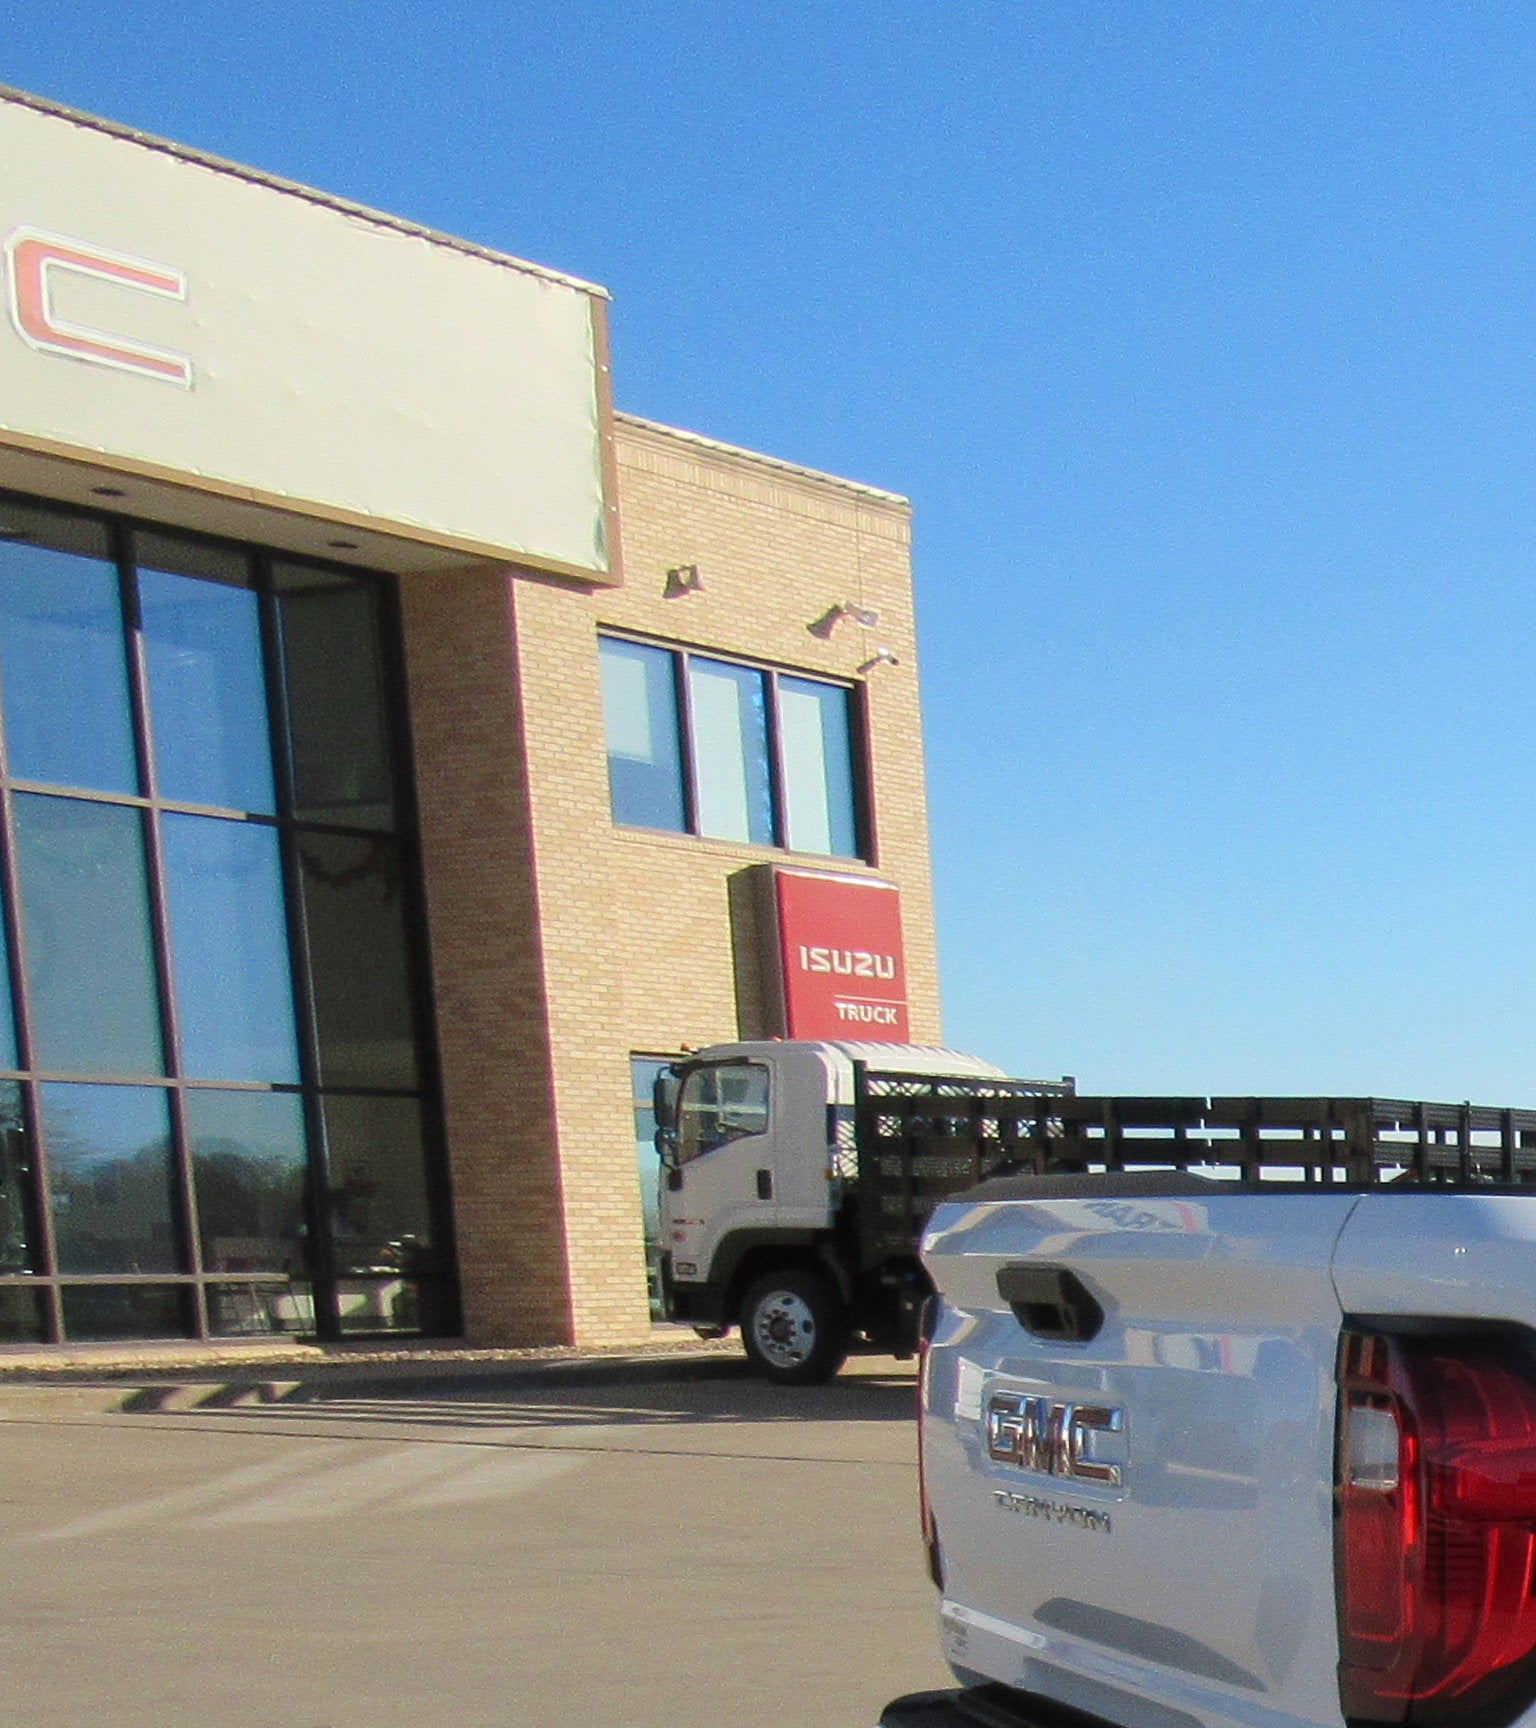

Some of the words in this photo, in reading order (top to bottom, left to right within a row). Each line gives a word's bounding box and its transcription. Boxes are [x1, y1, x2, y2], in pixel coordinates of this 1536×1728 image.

[799, 946, 896, 980] ISUZU
[834, 1003, 898, 1025] TRUCK
[988, 1397, 1125, 1486] GMC
